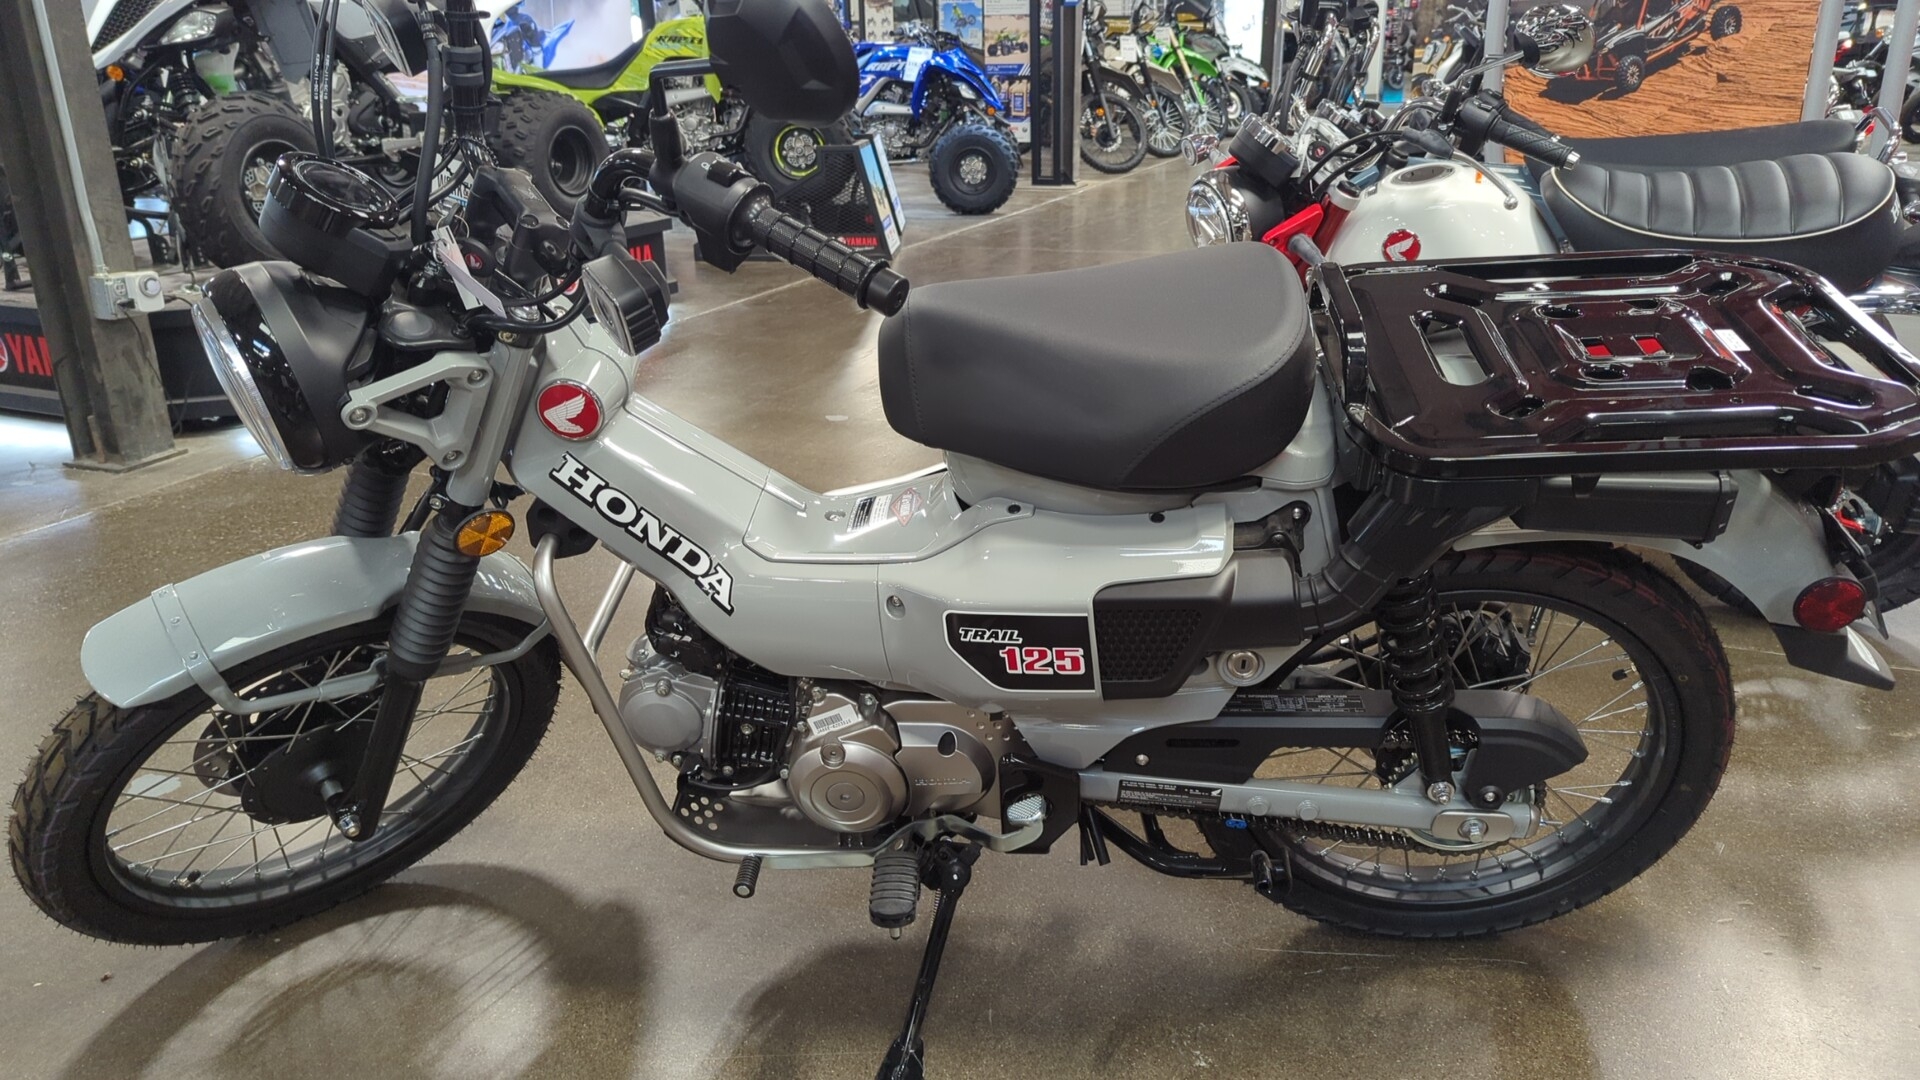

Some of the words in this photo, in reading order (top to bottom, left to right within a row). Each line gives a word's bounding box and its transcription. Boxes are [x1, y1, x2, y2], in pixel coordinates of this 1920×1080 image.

[846, 236, 878, 246] YAMAHA
[549, 451, 735, 617] HONDA
[959, 627, 1023, 644] TRAIL
[999, 646, 1086, 675] 125
